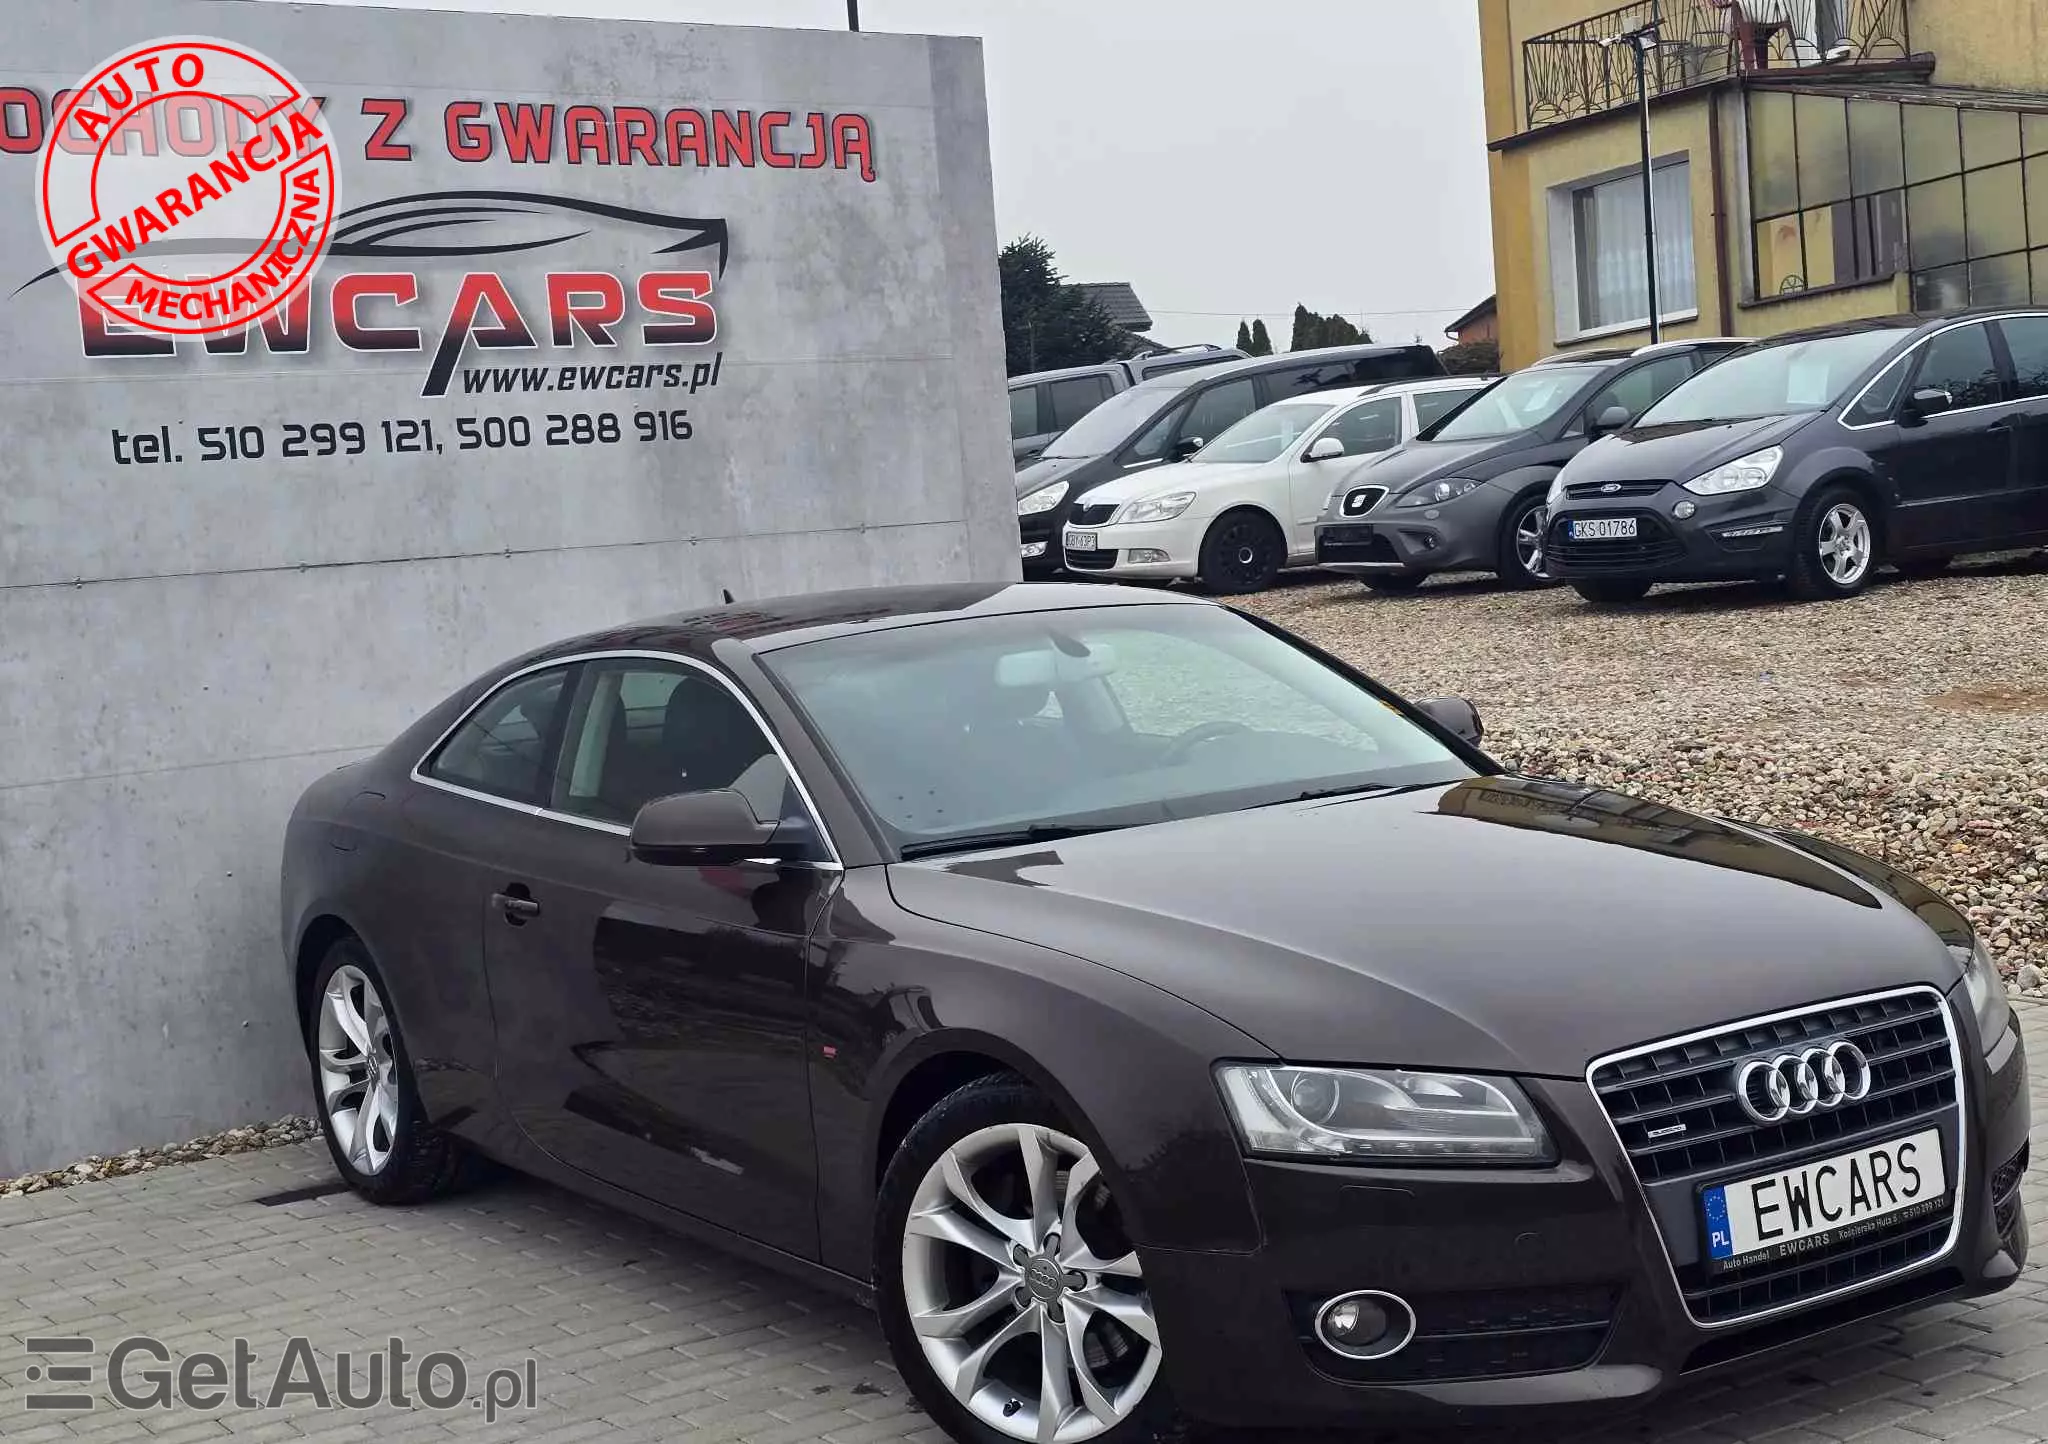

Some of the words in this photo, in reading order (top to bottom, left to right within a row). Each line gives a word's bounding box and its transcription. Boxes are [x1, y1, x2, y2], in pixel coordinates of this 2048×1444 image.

[361, 98, 413, 161] Z
[444, 101, 876, 182] GWARANCJĄ
[75, 271, 718, 398] EWCARS
[462, 352, 724, 395] www.ewcars.pl
[112, 429, 183, 464] tel.
[199, 426, 265, 461] 510
[282, 422, 366, 457] 299
[381, 419, 443, 456] 121,
[456, 415, 531, 451] 500
[545, 412, 621, 447] 288
[633, 410, 693, 442] 916
[1751, 1142, 1921, 1241] EWCARS
[1711, 1231, 1730, 1248] PL
[1779, 1233, 1831, 1258] EWCARS
